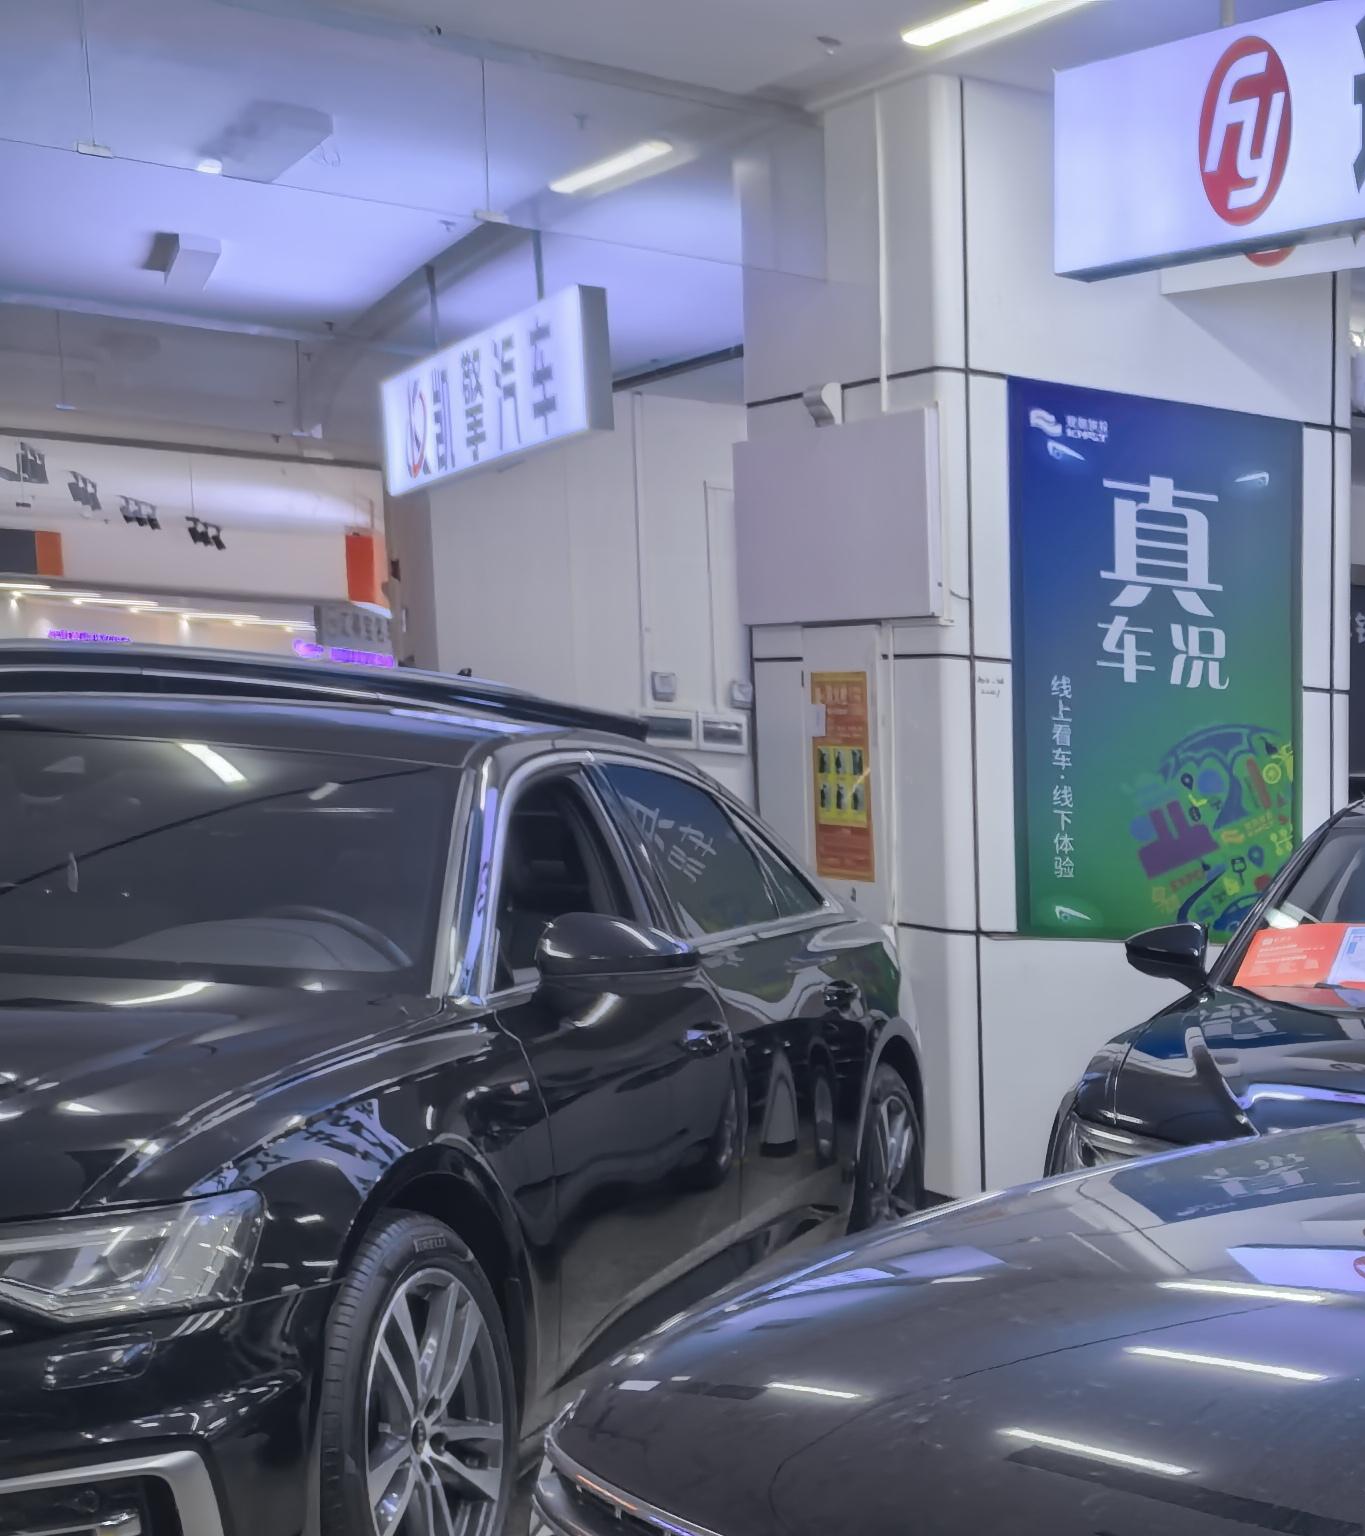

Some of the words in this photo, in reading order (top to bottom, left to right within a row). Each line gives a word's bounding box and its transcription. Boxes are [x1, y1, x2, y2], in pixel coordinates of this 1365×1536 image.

[1100, 474, 1224, 618] 真
[1096, 614, 1230, 690] 车况
[1051, 674, 1075, 879] 线上看车·线下体验
